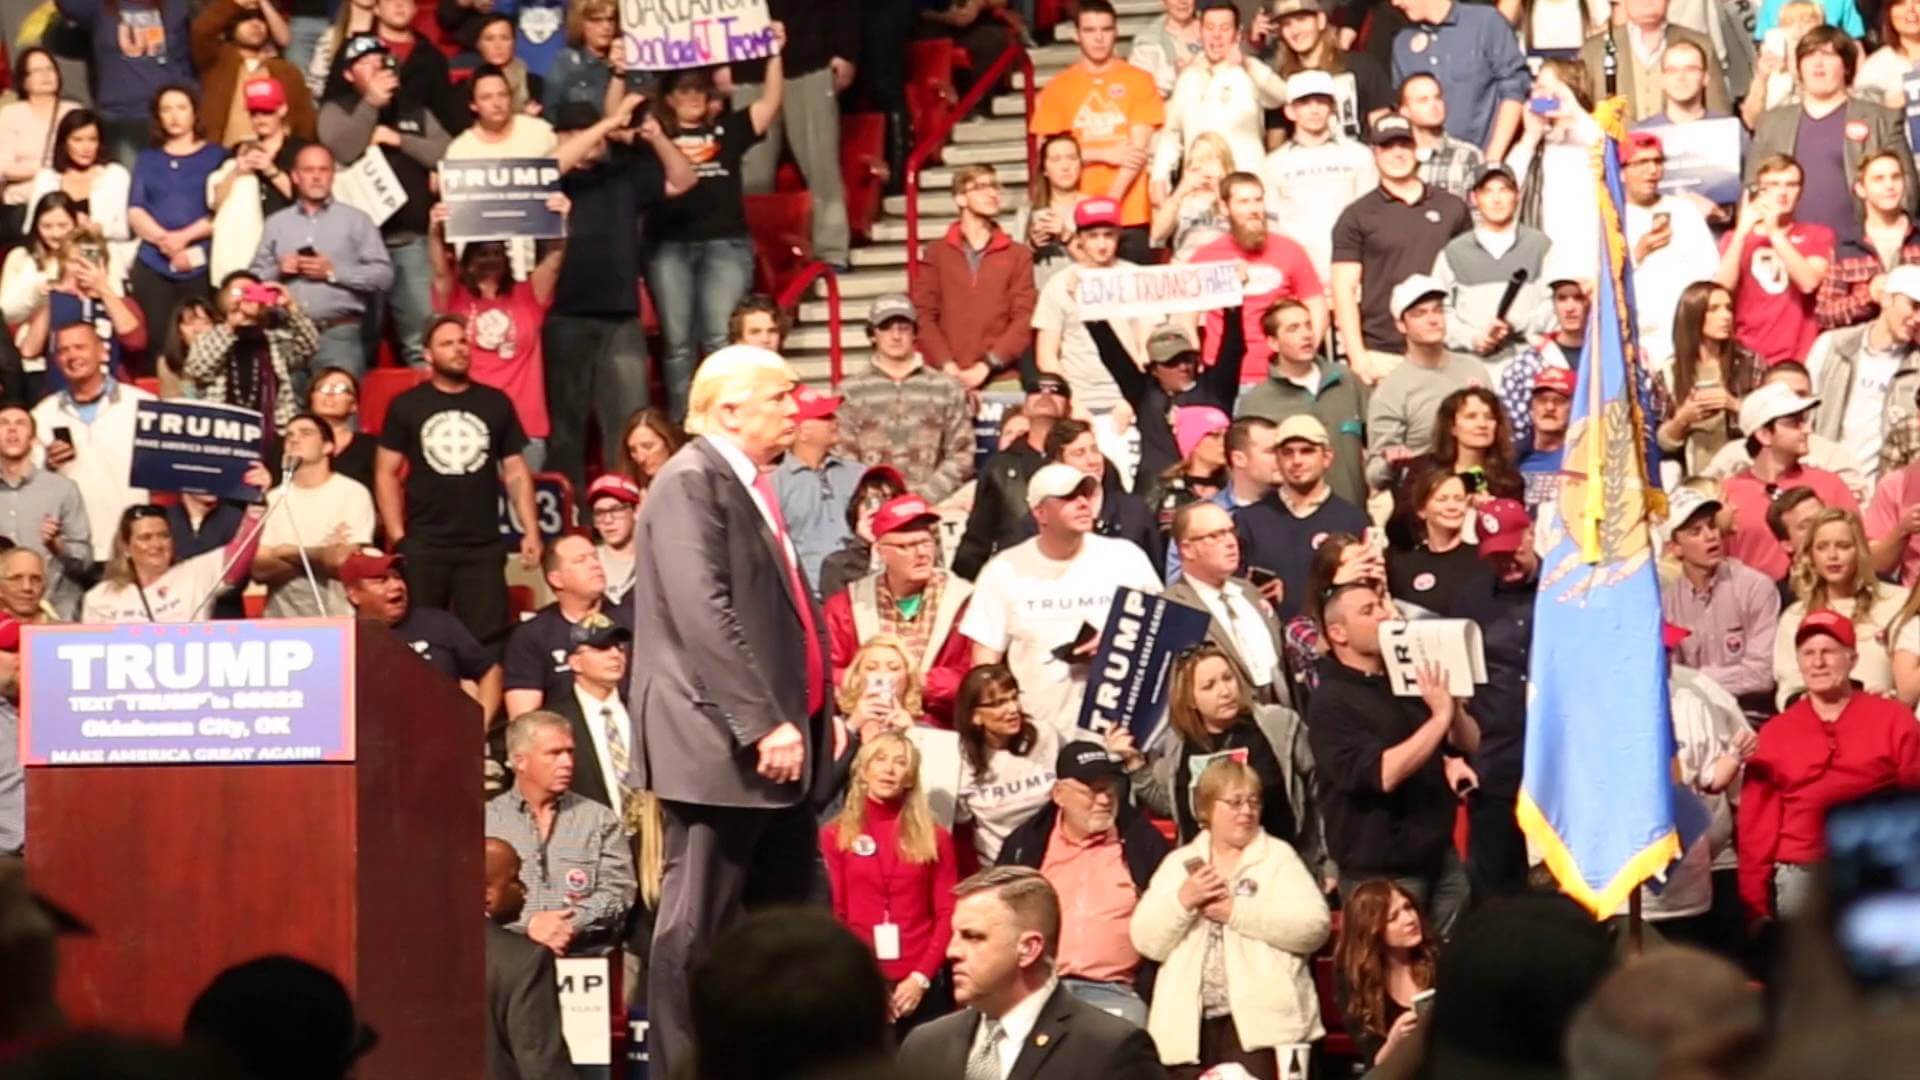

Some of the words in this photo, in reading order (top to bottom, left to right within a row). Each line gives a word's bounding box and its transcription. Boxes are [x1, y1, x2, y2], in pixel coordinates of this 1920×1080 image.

[444, 167, 560, 189] TRUMP
[137, 410, 262, 443] TRUMP
[1026, 596, 1112, 611] TRUMP
[57, 640, 314, 690] TRUMP
[1089, 590, 1146, 732] TRUMP
[198, 716, 251, 739] City,
[254, 715, 292, 735] OK
[51, 749, 104, 763] MAKE
[108, 748, 191, 762] AMERICA
[194, 747, 255, 761] GREAT
[257, 745, 321, 760] AGAIN!
[980, 772, 1057, 802] TRUMP
